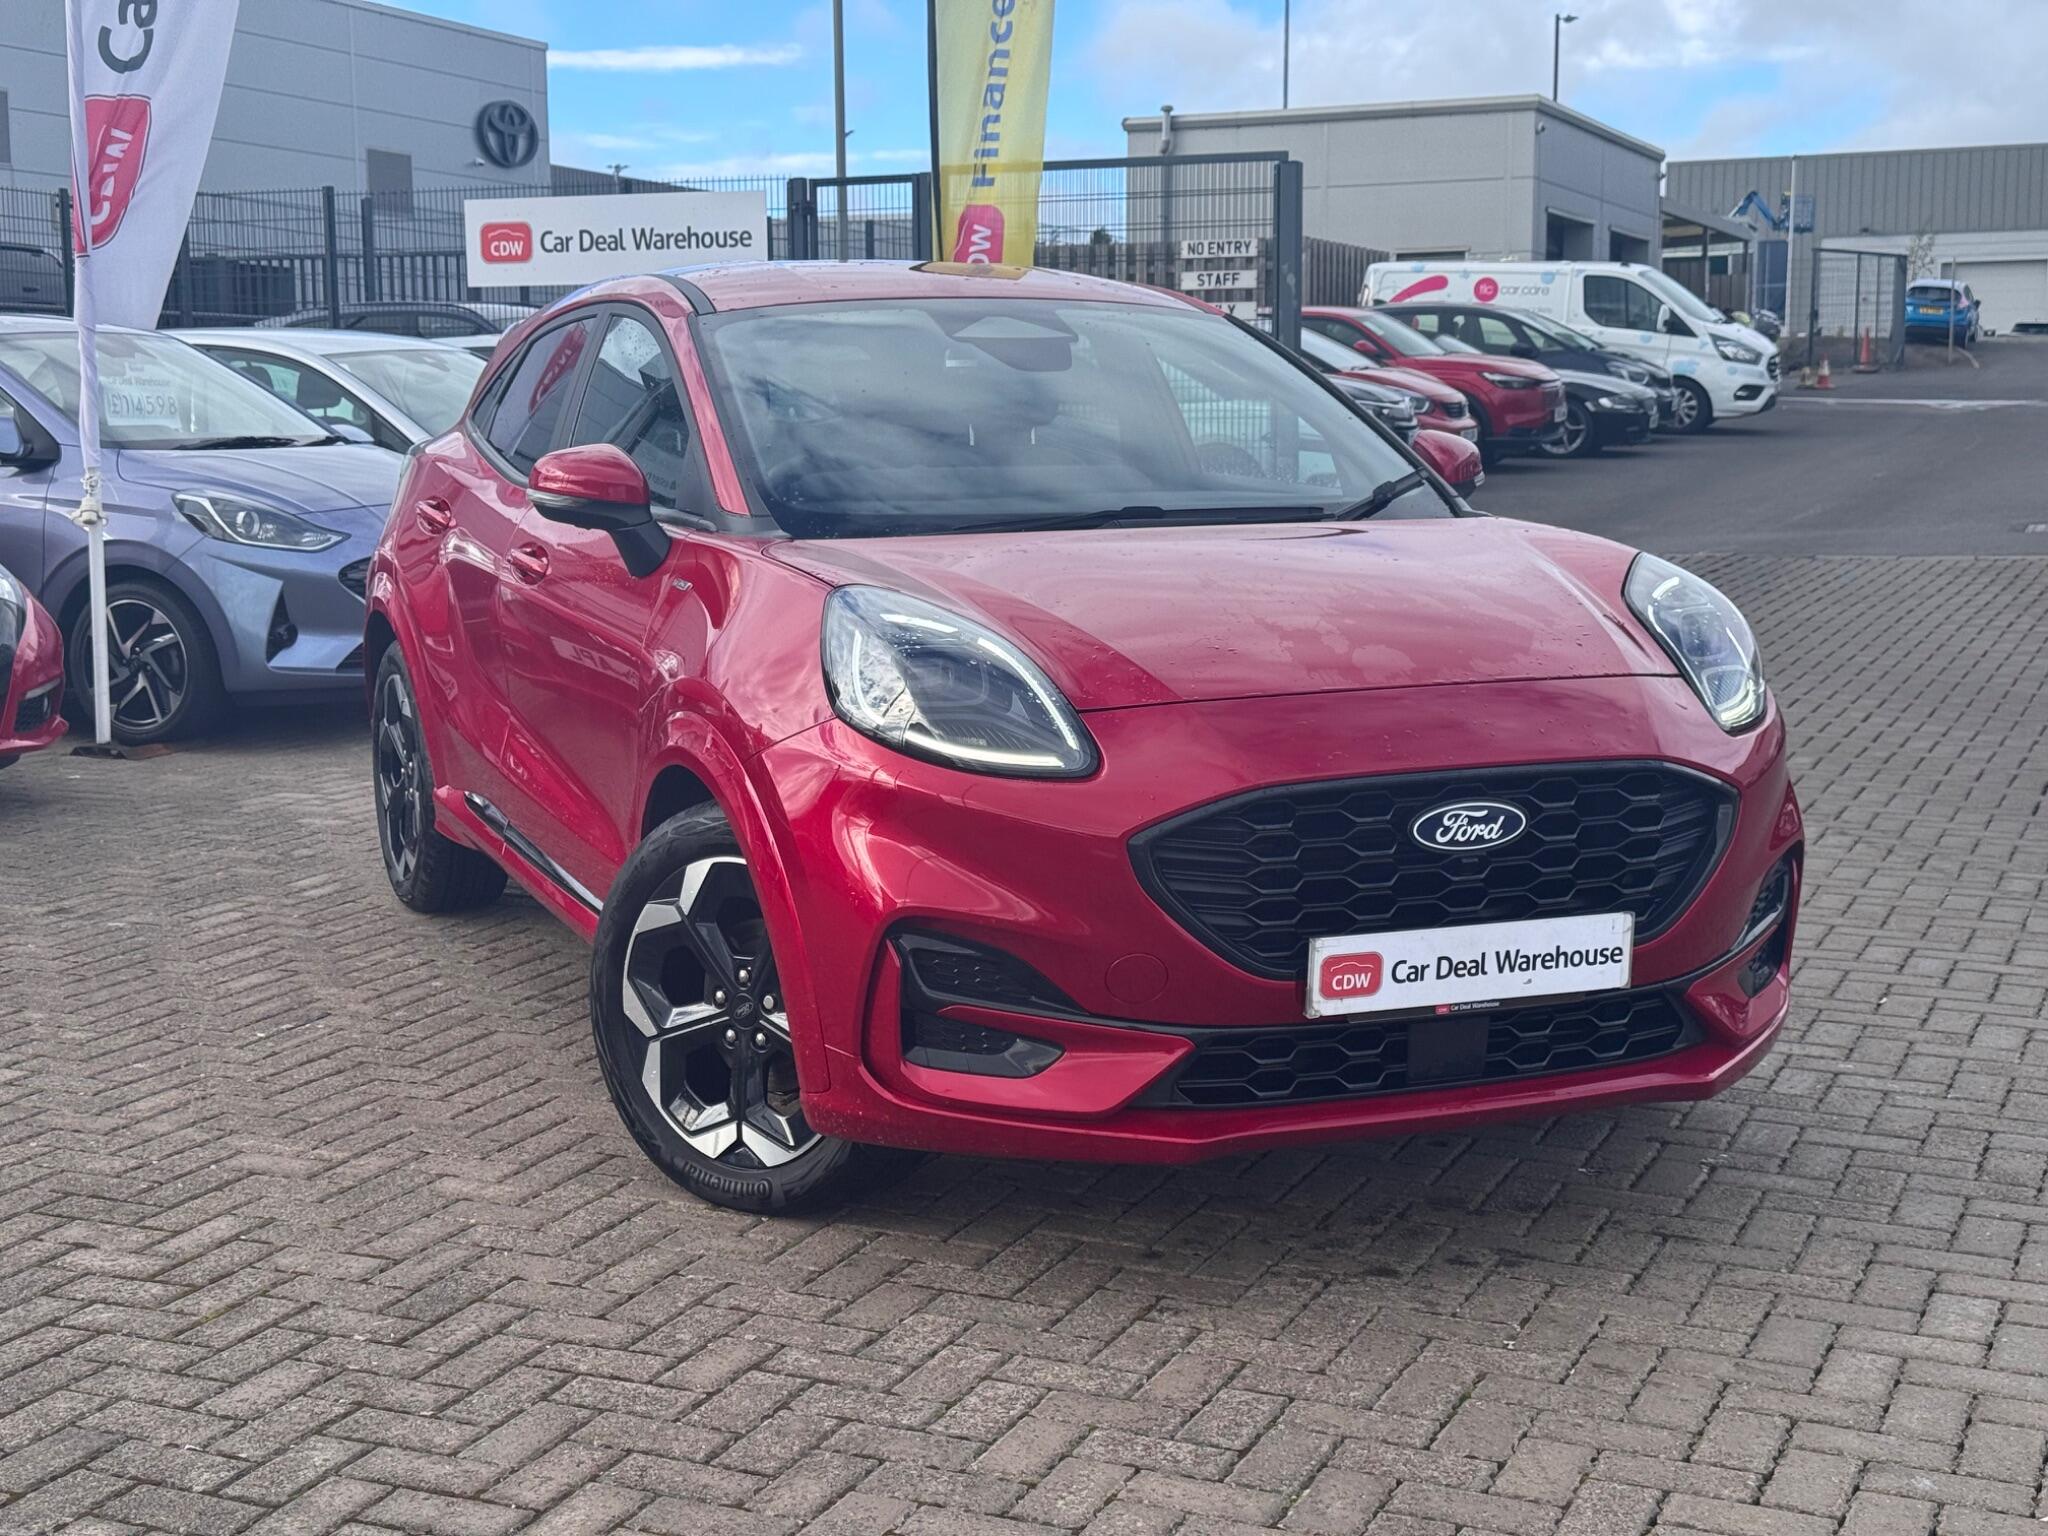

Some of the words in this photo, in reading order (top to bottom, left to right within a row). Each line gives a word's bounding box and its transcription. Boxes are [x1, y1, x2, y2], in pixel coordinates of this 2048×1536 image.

[490, 240, 524, 257] CDW
[540, 231, 574, 253] Car
[579, 228, 626, 252] Deal
[632, 226, 753, 251] Warehouse
[967, 224, 992, 264] DW
[1187, 242, 1204, 256] NO
[1208, 240, 1251, 255] ENTRY
[1197, 272, 1240, 287] STAFF
[1436, 809, 1505, 843] Ford
[1391, 960, 1430, 984] Car
[1435, 952, 1487, 980] Deal
[1496, 945, 1623, 974] Warehouse
[1332, 972, 1371, 992] CDW
